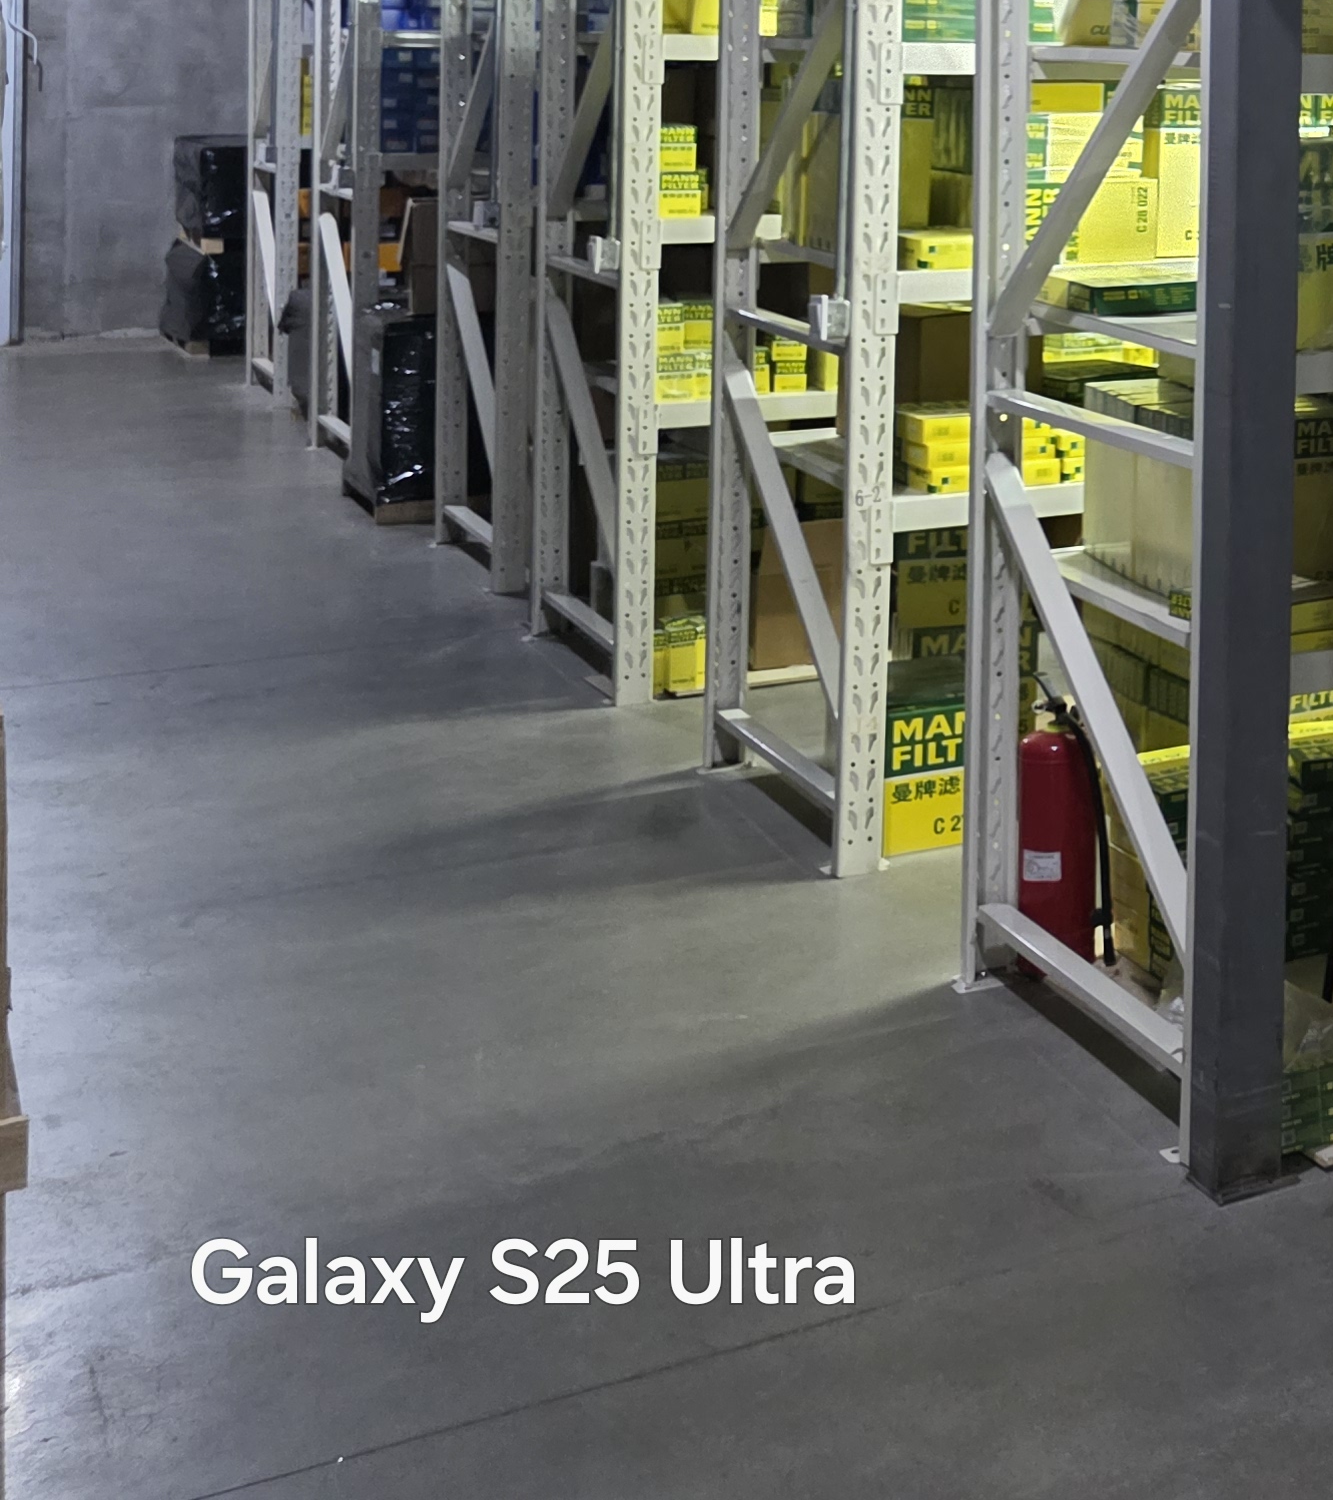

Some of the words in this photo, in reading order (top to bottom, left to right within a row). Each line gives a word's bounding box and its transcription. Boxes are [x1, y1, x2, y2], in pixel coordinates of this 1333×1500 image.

[892, 738, 962, 770] FILT
[892, 775, 961, 804] 曼牌滤
